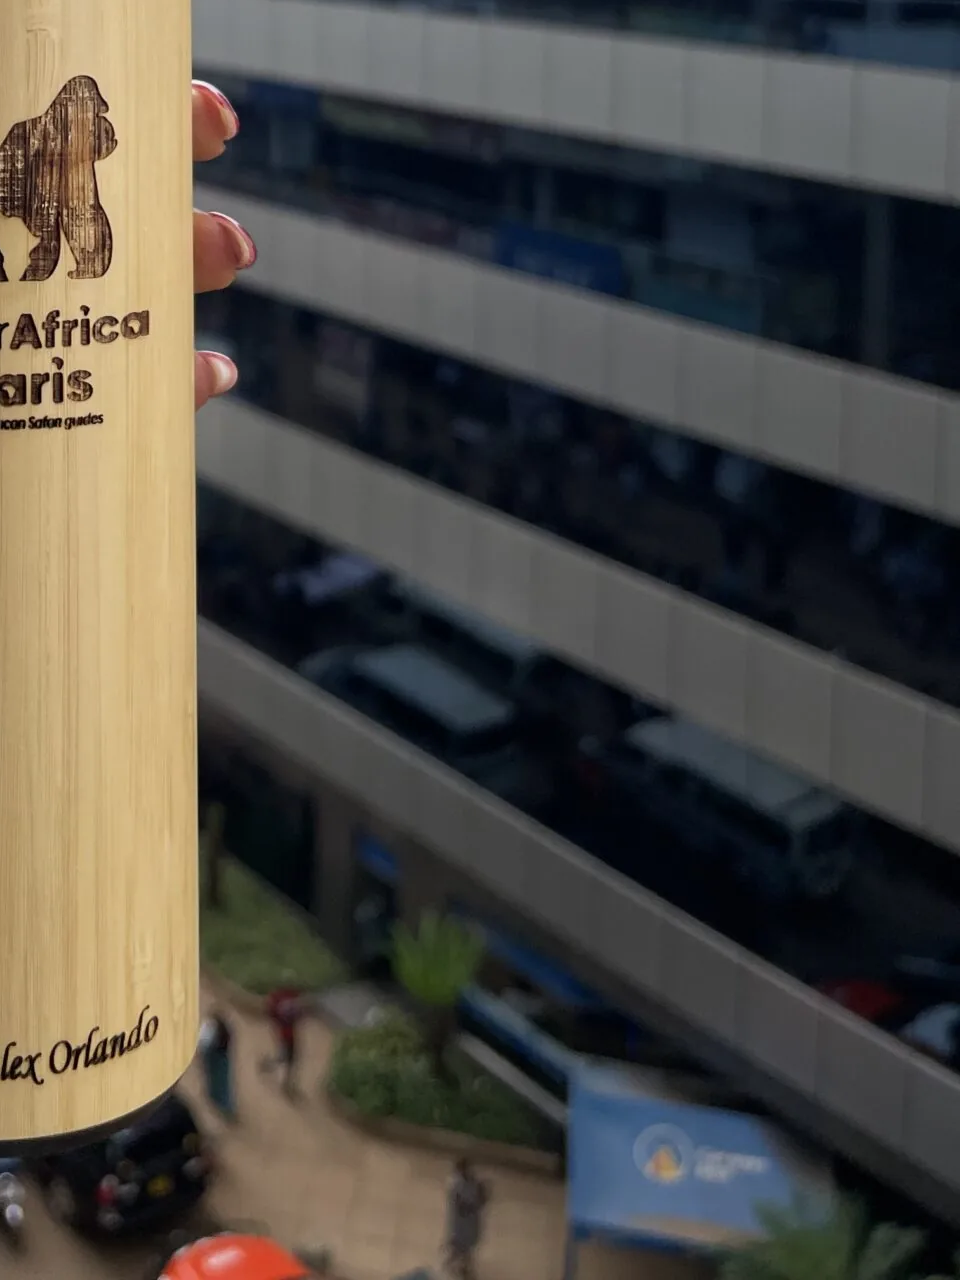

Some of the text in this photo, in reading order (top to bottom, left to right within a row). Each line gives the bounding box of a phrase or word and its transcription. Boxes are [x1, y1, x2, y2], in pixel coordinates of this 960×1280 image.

[28, 414, 62, 429] Safari
[64, 412, 104, 429] guides
[49, 1004, 159, 1074] Orlando
